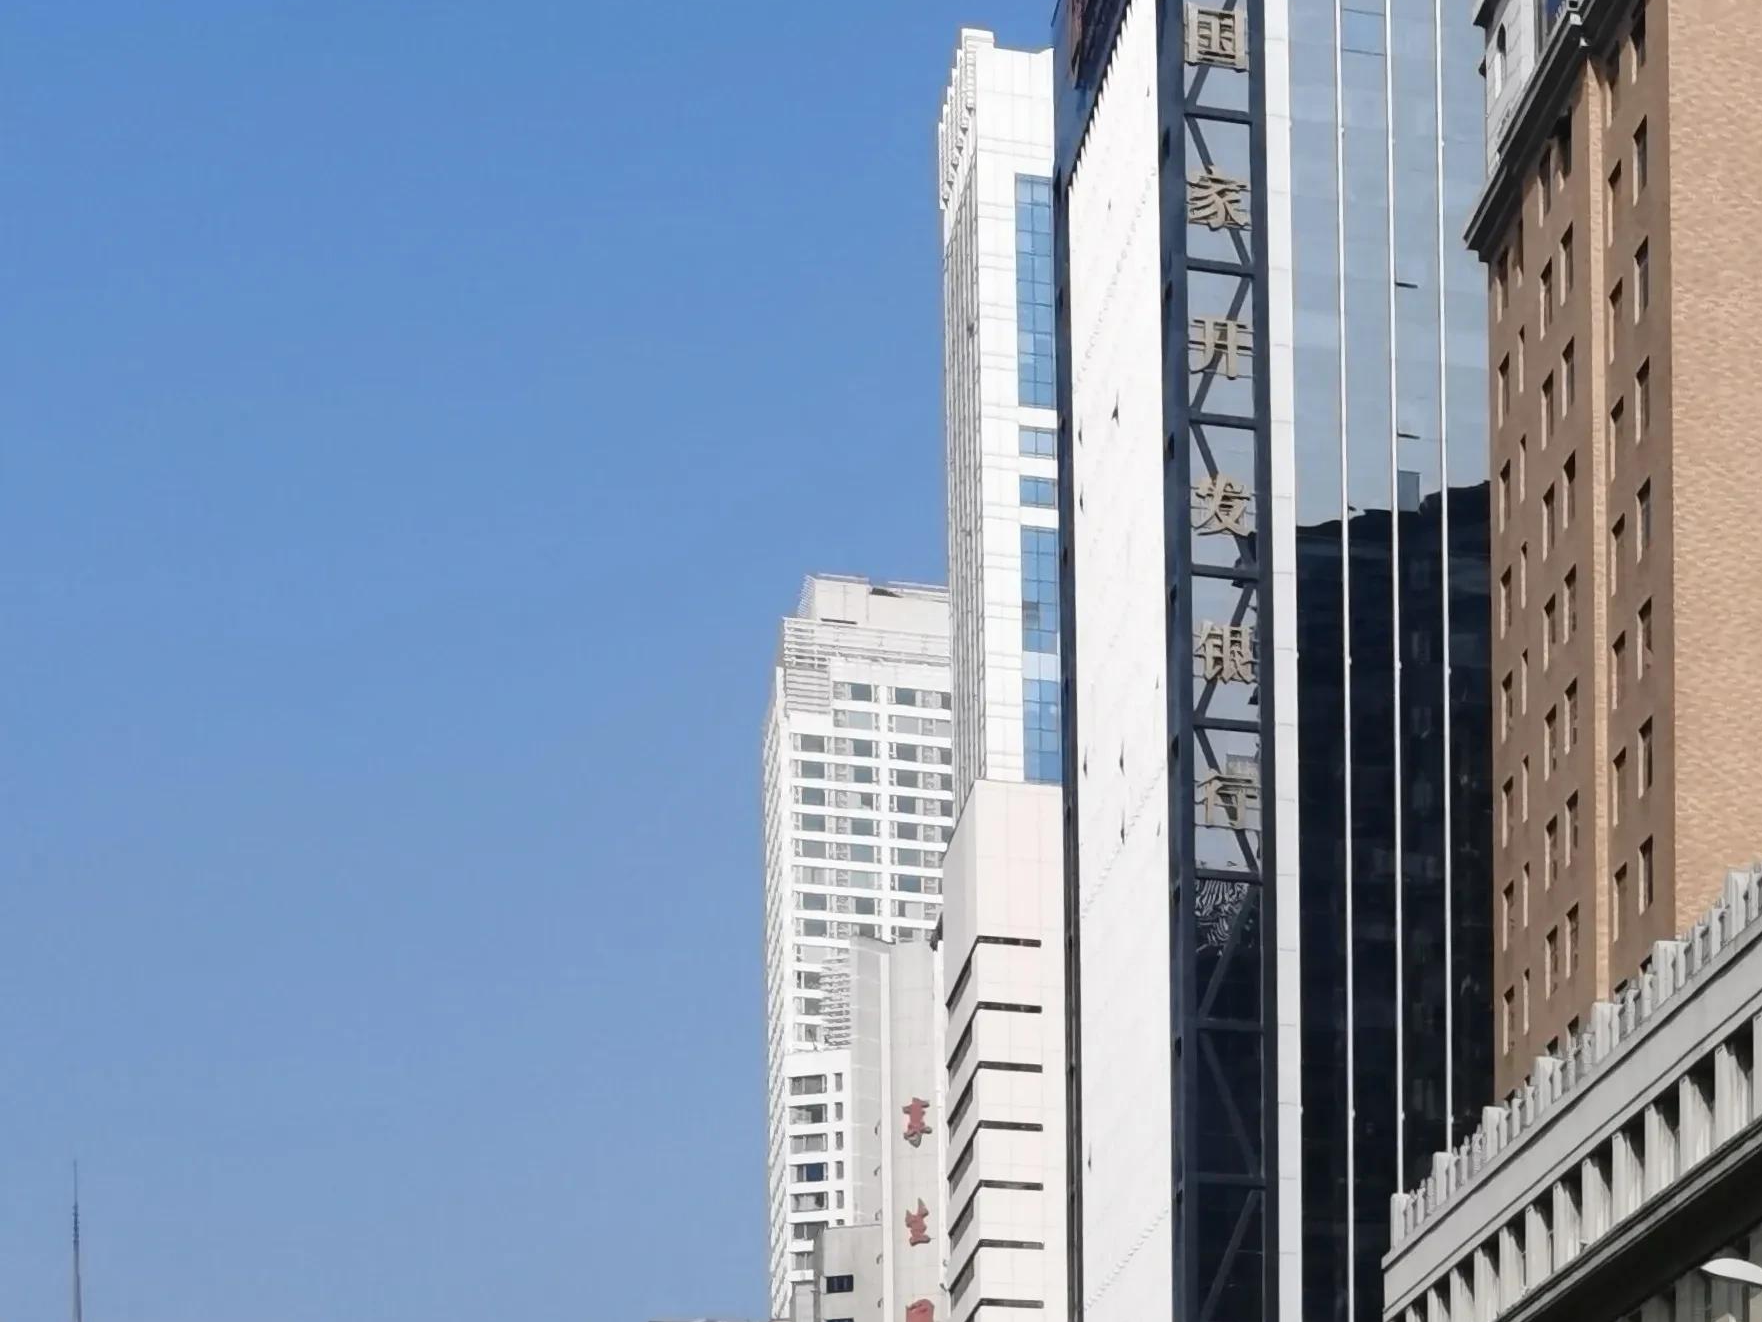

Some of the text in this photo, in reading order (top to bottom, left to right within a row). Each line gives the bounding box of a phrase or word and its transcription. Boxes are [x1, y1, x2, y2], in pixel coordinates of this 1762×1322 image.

[1183, 2, 1258, 830] 国家开发银行
